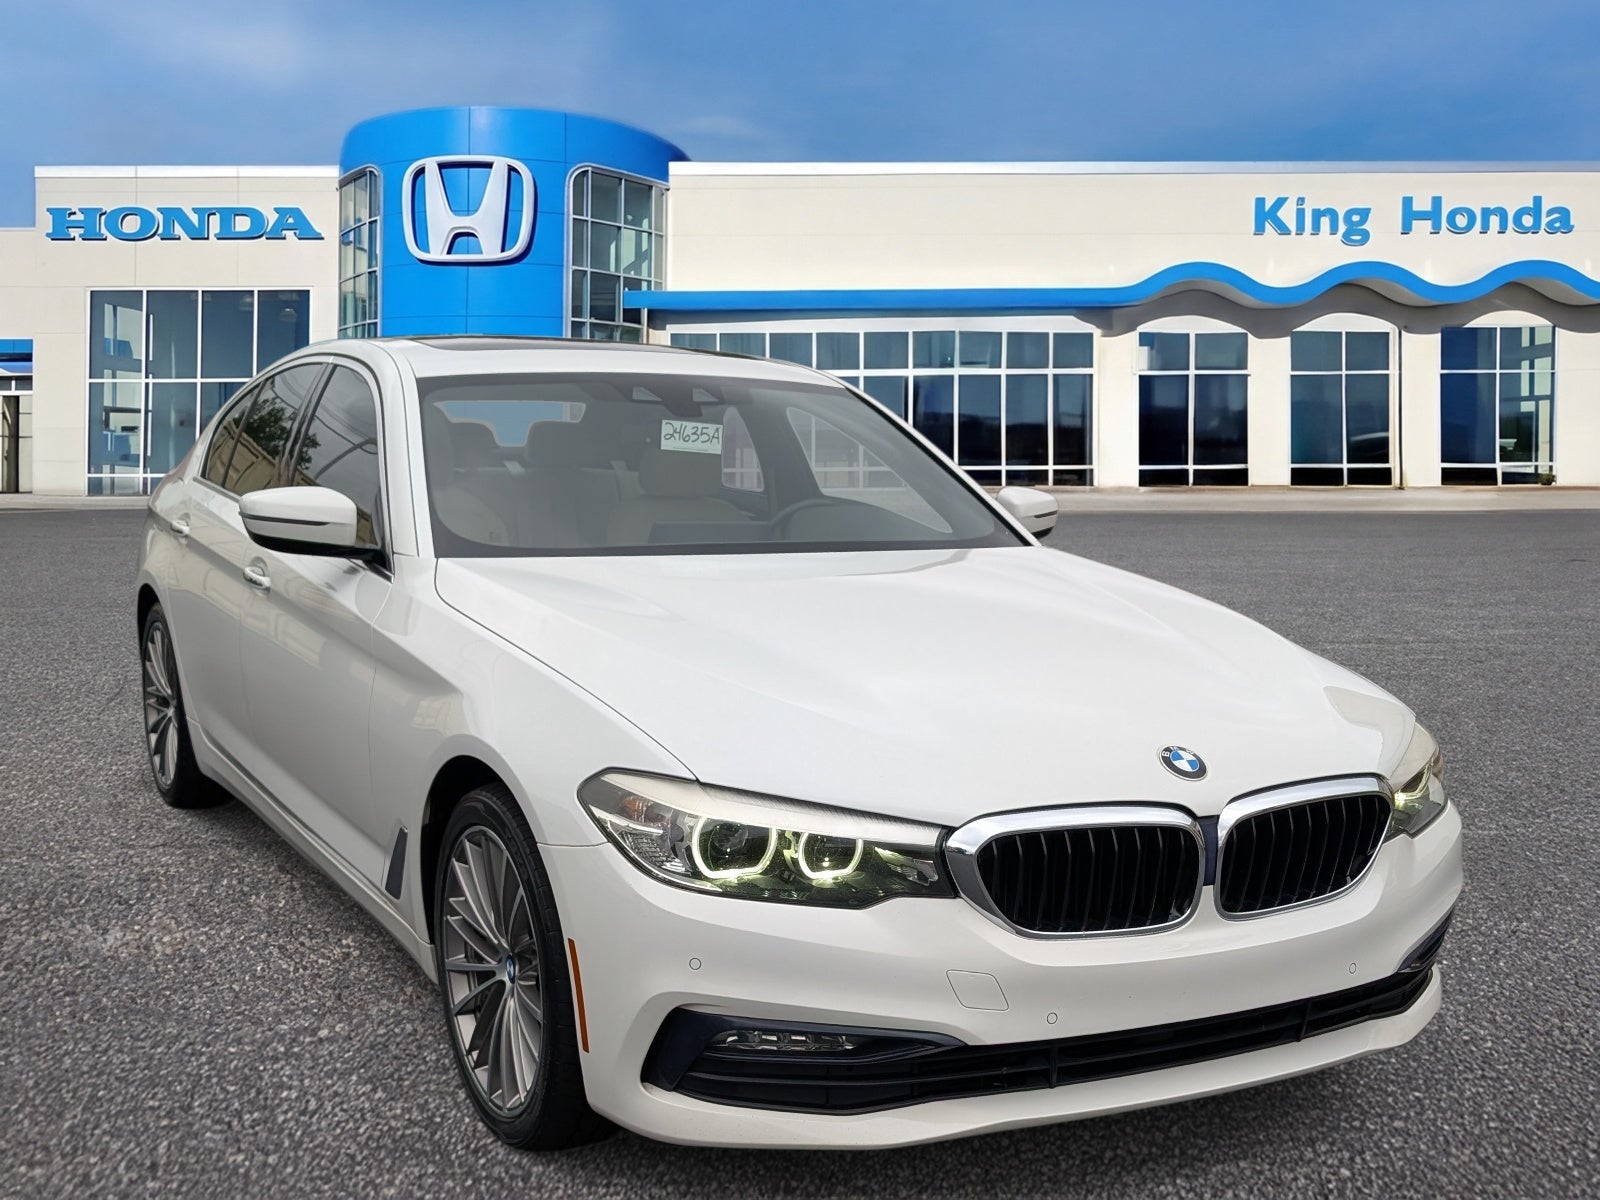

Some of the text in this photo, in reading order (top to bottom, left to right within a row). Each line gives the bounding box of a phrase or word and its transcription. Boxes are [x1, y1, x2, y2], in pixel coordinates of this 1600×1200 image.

[45, 206, 325, 242] HONDA
[1253, 195, 1575, 246] King Honda
[663, 421, 721, 445] 24635A
